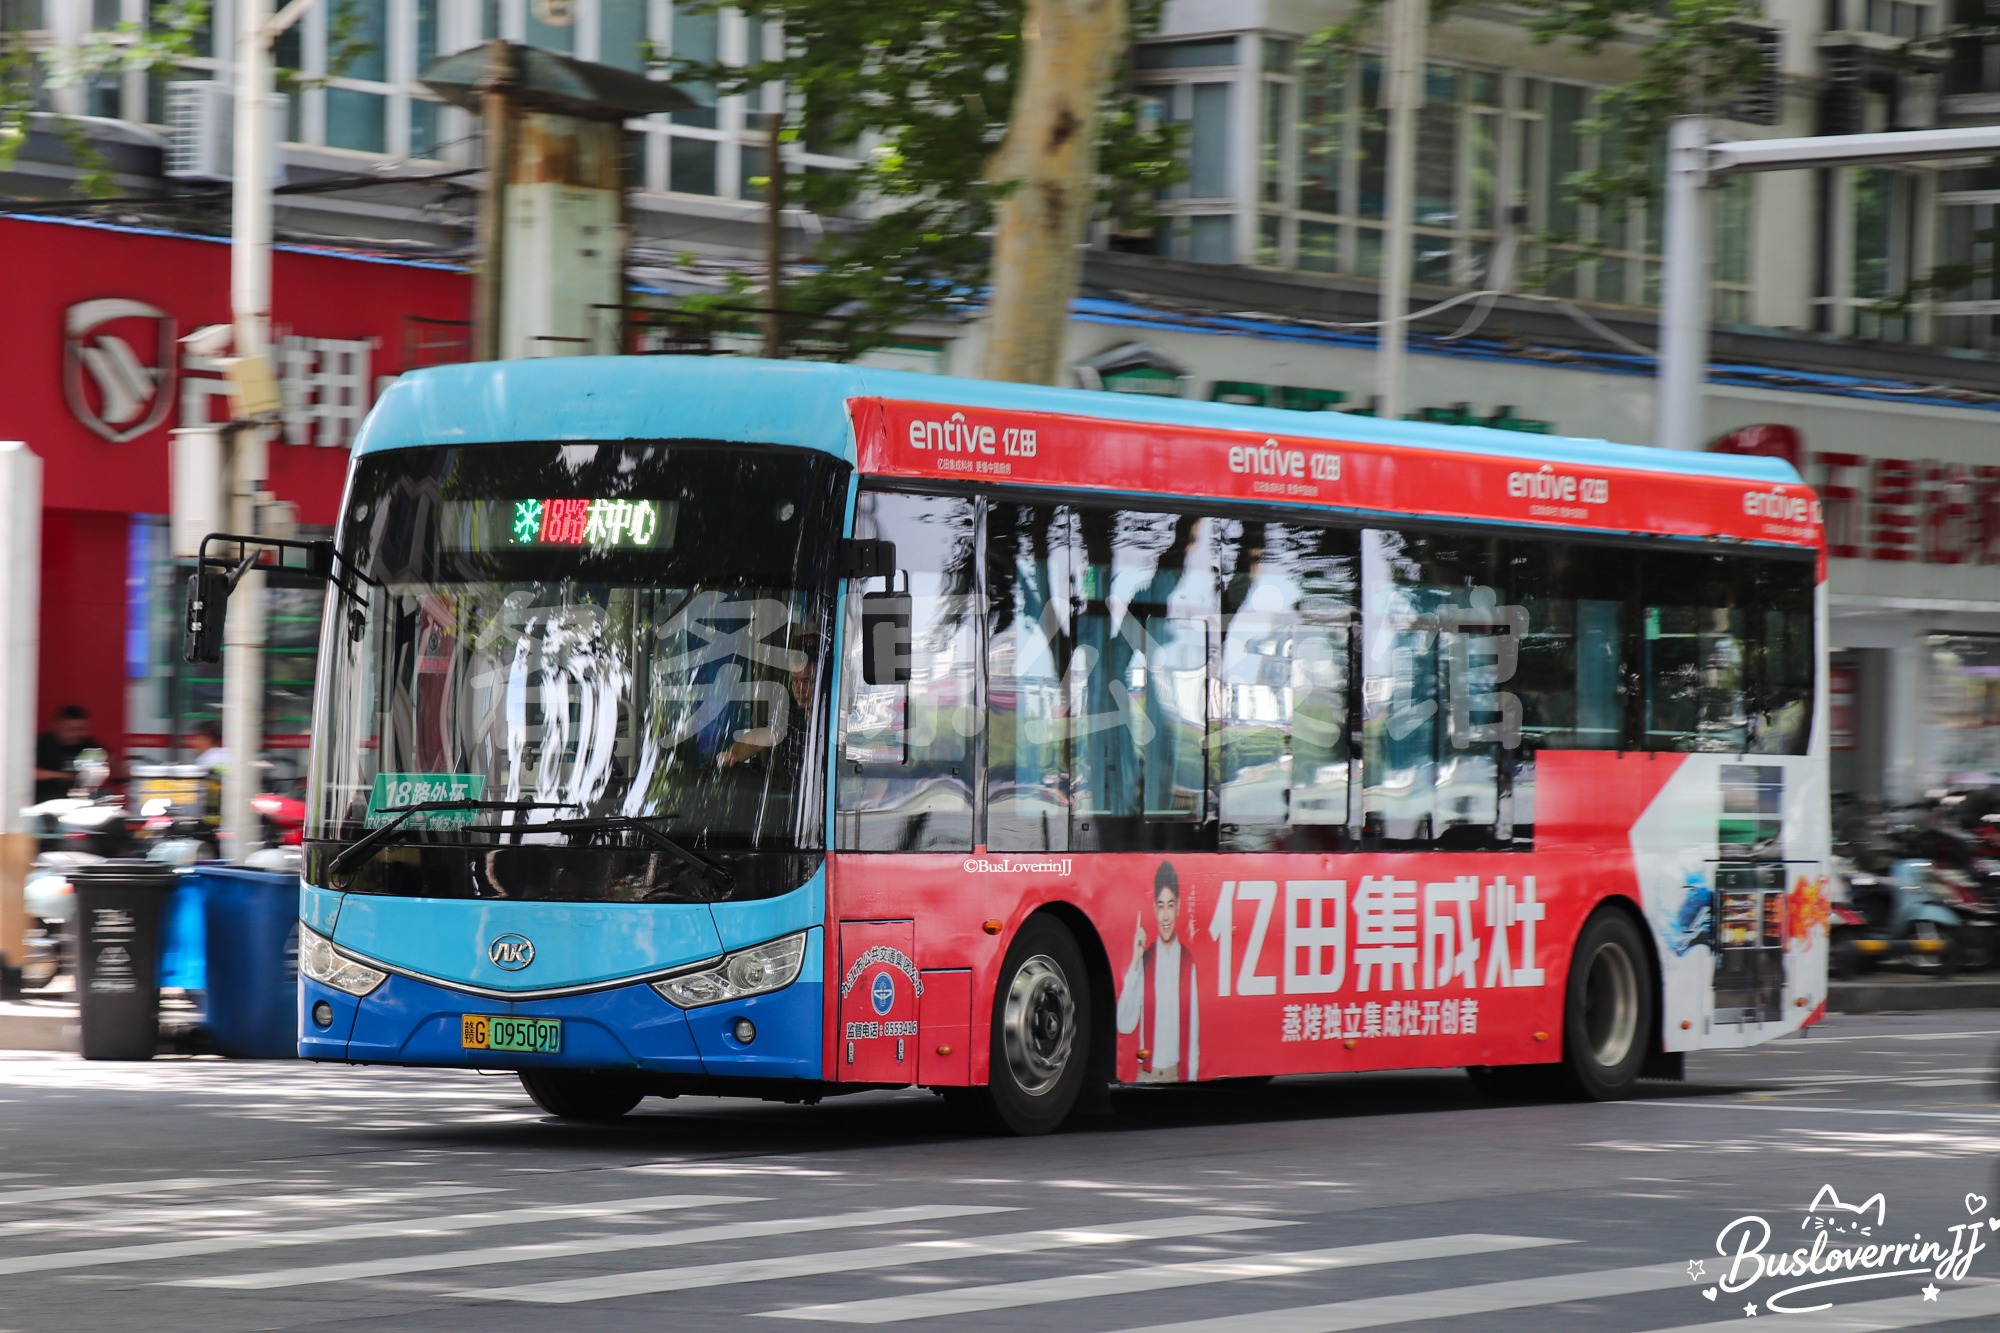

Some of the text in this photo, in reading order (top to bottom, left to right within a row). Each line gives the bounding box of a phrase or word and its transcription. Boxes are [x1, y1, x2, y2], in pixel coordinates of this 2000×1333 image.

[1002, 428, 1037, 457] 亿田
[1309, 453, 1341, 481] 亿田
[1580, 478, 1609, 504] 亿田
[1208, 875, 1546, 997] 亿田集成灶
[1281, 998, 1479, 1042] 蒸烤独立集成灶开创者
